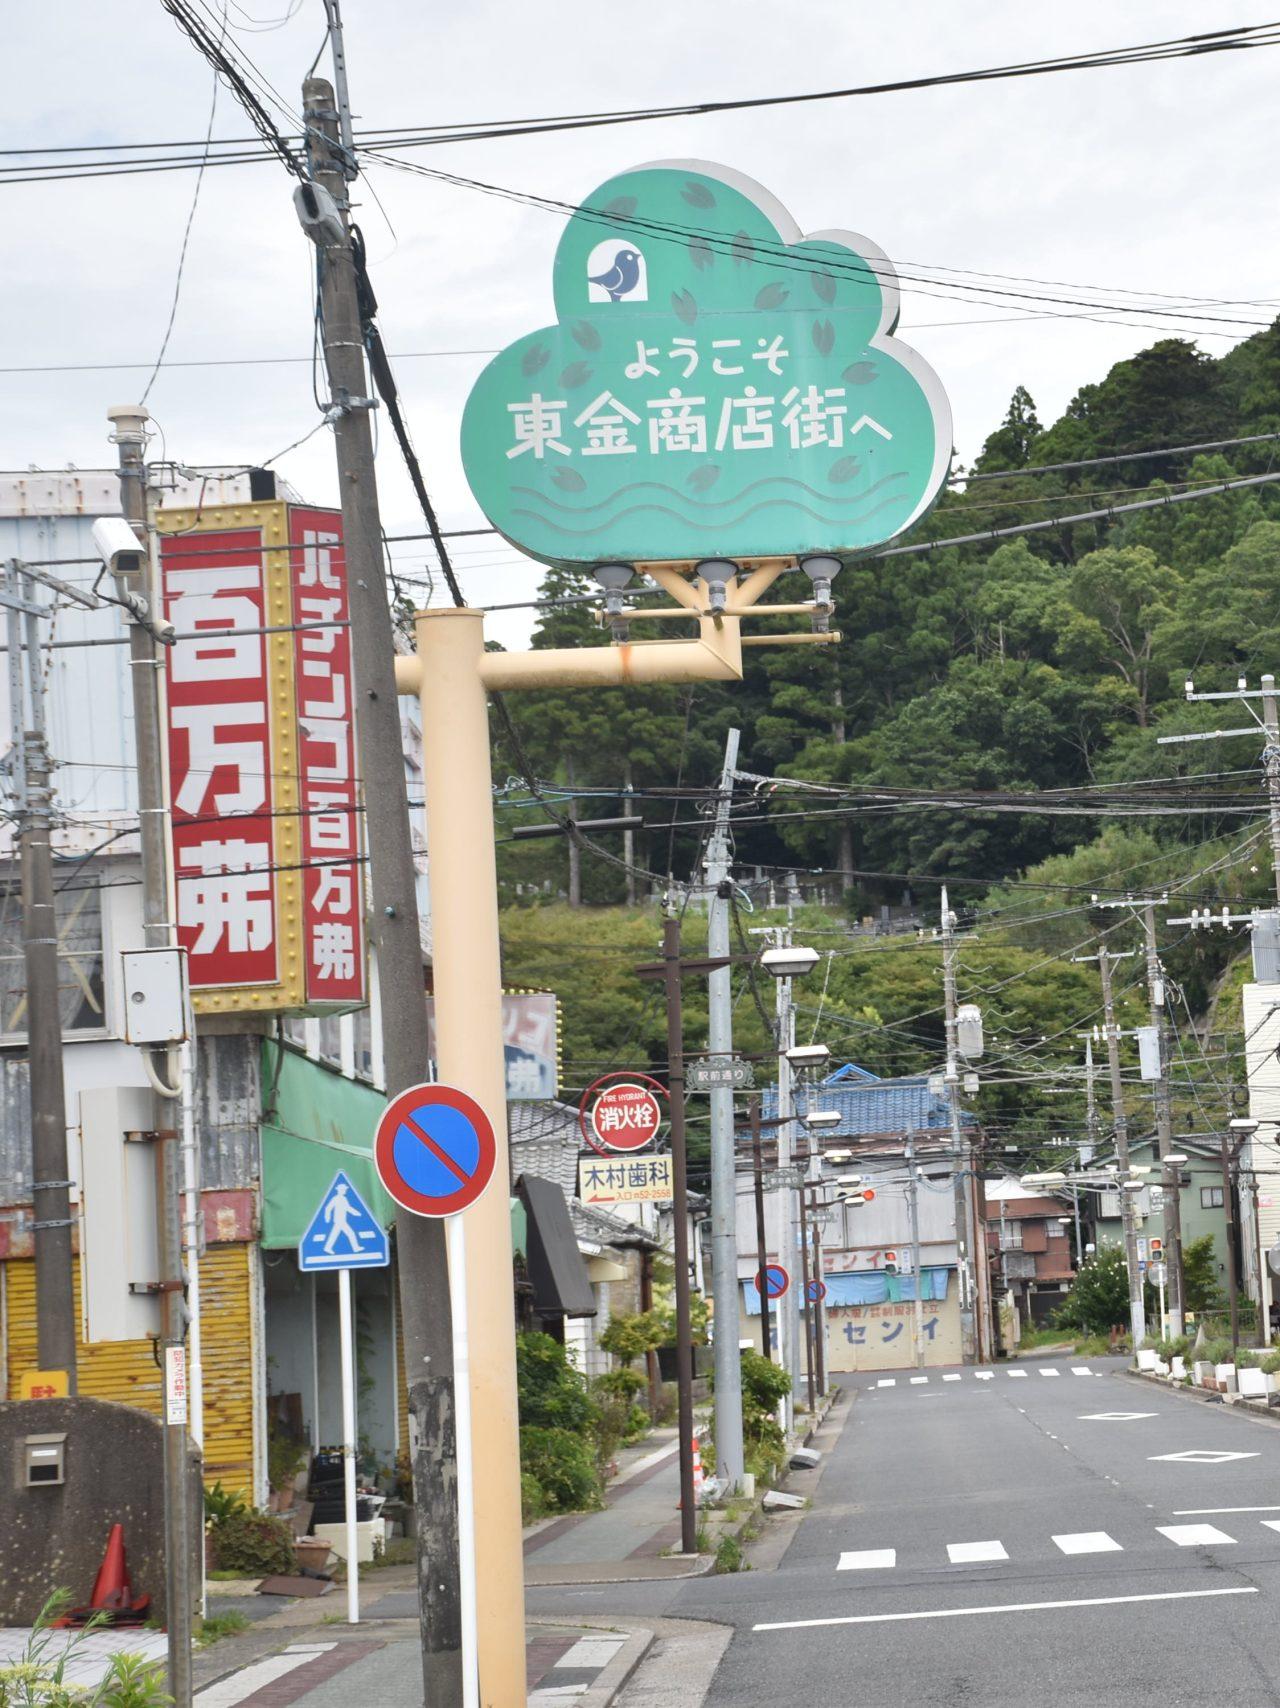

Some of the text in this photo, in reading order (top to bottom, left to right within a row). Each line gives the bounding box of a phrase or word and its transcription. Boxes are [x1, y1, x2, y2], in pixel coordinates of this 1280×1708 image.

[624, 334, 789, 379] ようこそ
[505, 385, 893, 460] 東金商店街へ
[697, 1069, 744, 1081] 駅前通り
[618, 1092, 646, 1101] HYDRANT
[599, 1103, 654, 1131] 消火栓
[584, 1161, 669, 1190] 木村歯科
[616, 1192, 632, 1200] 入口
